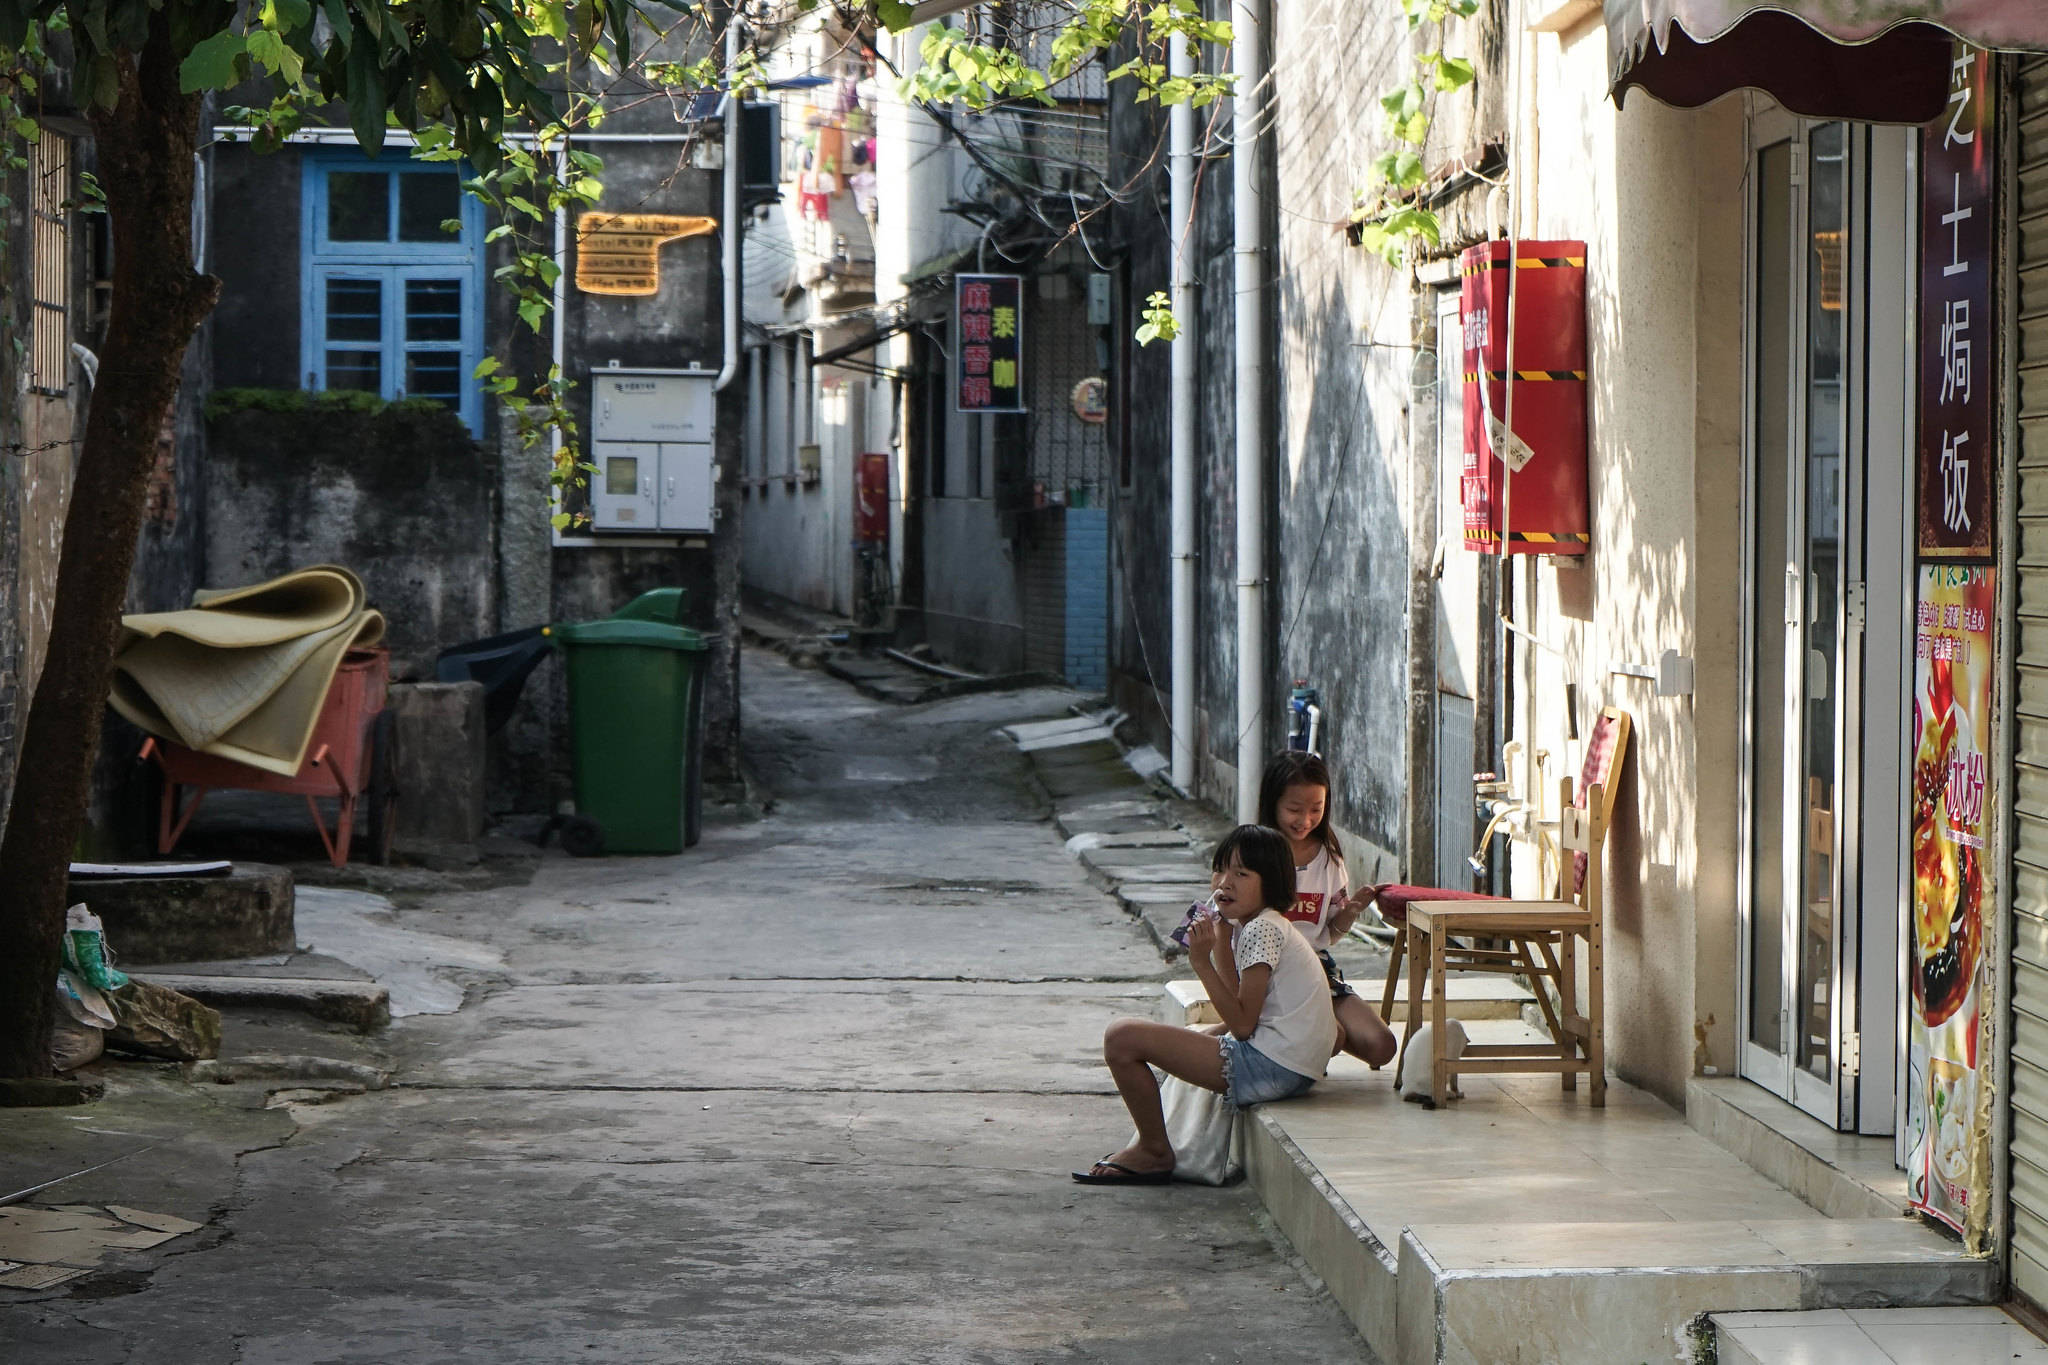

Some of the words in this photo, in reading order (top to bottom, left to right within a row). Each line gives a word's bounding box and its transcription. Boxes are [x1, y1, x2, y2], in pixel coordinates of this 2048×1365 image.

[962, 283, 992, 407] 麻辣香锅
[1939, 43, 1976, 533] 芝士焗饭
